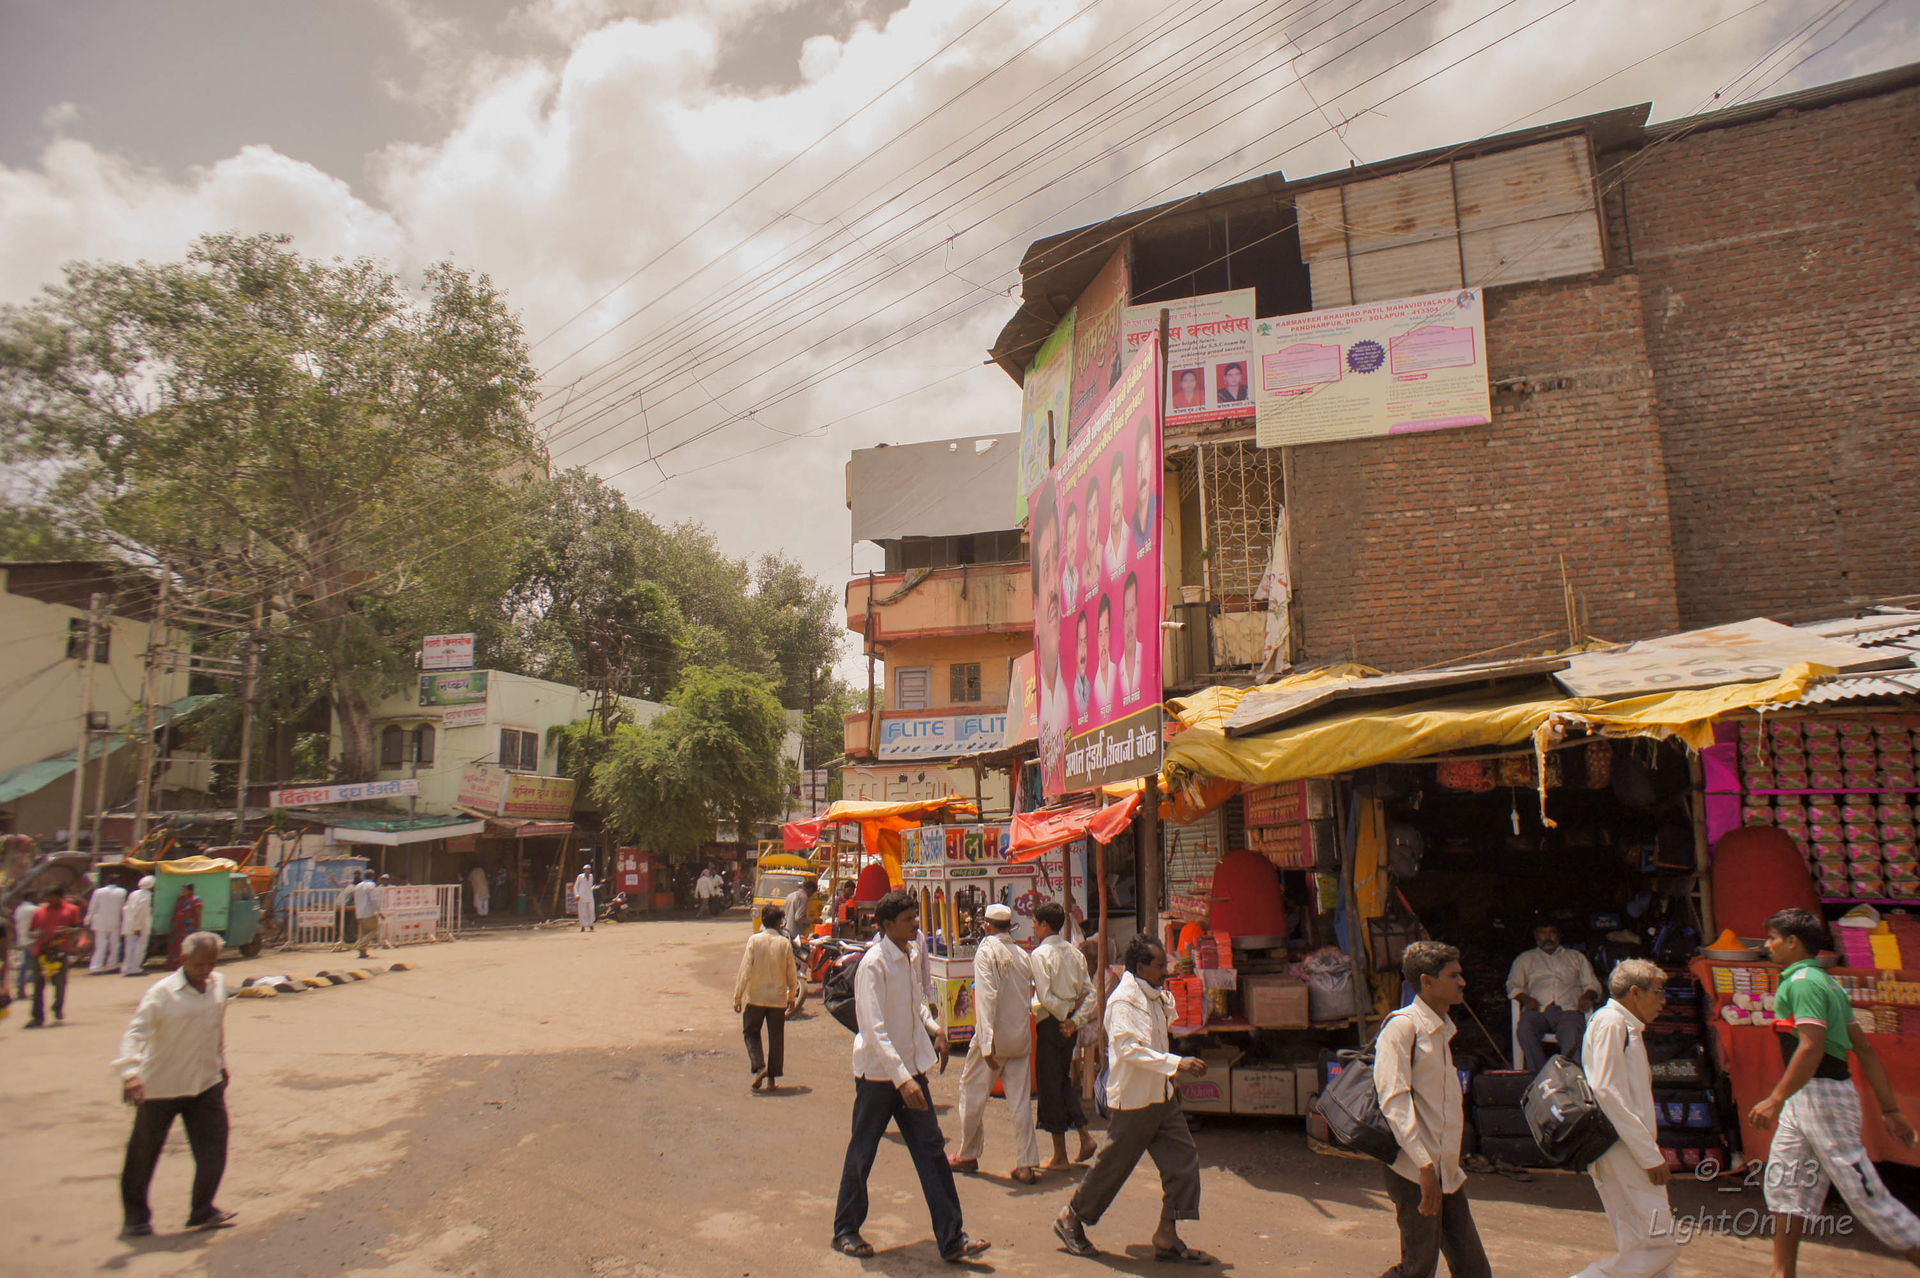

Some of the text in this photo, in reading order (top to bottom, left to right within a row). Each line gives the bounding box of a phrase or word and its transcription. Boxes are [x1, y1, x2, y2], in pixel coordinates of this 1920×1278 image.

[1186, 314, 1250, 338] क्लासेस
[1275, 298, 1454, 328] KARMAVEER BHAURAO PATIL MAHAVIDYALAYA
[1369, 311, 1405, 321] SOLAPUR
[888, 720, 945, 738] FLITE
[1106, 728, 1135, 766] शिवाजी
[1135, 724, 1157, 758] चौक
[945, 827, 1001, 862] बादाम
